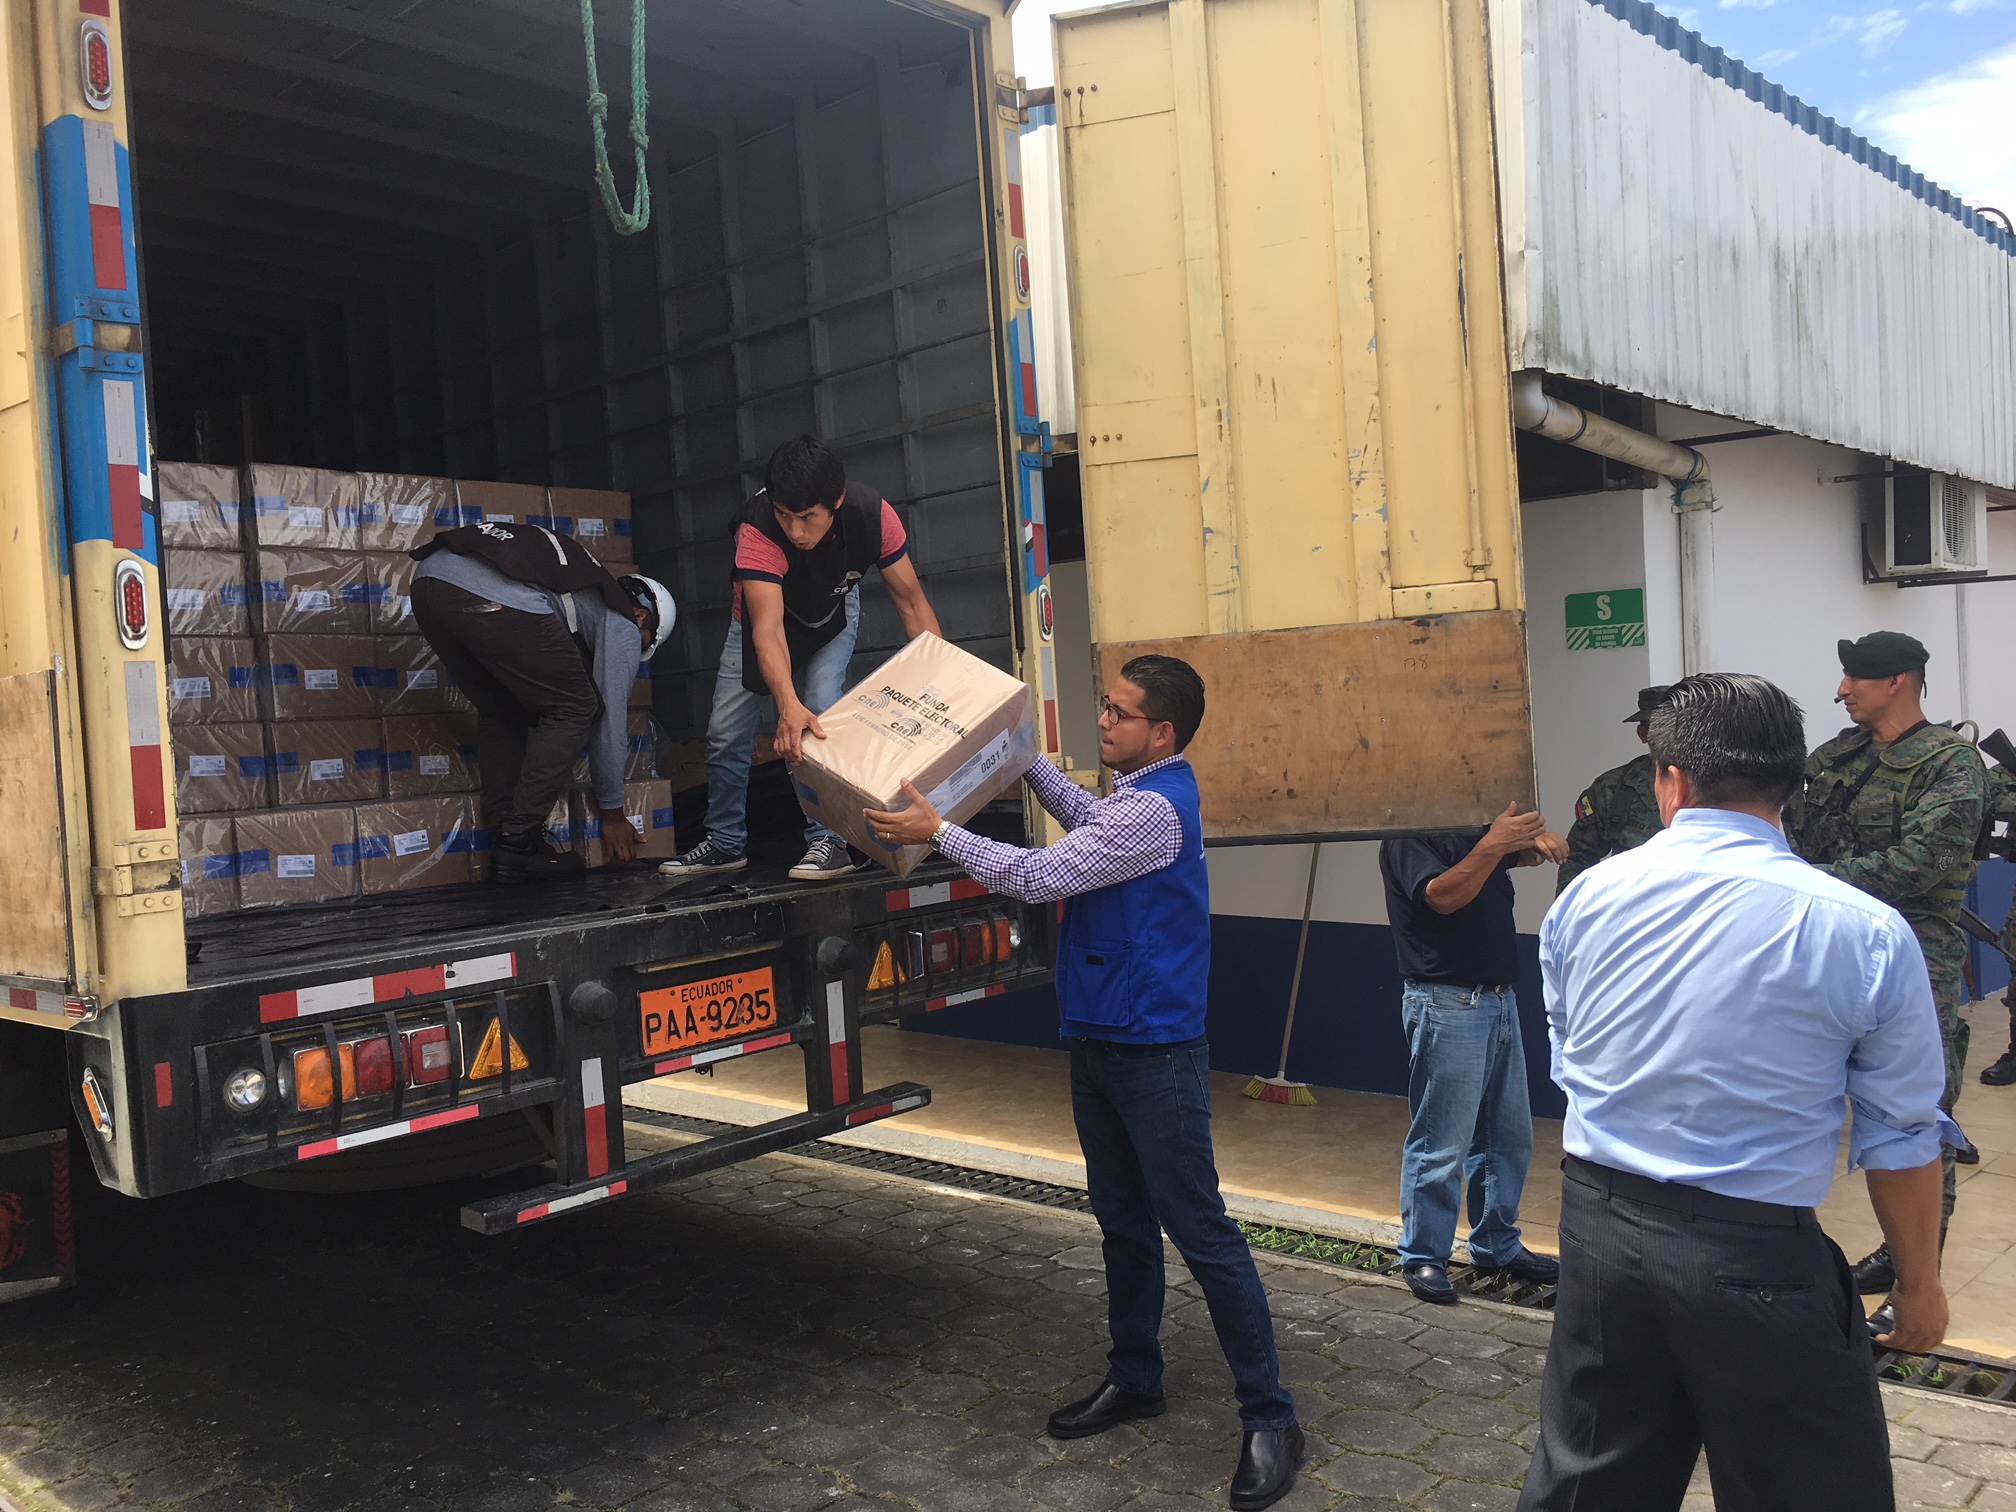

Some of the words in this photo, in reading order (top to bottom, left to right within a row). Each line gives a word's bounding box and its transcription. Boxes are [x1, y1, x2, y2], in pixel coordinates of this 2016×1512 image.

[1596, 594, 1612, 621] S
[880, 686, 920, 712] PAQUETE
[918, 707, 970, 740] ELECTORAL
[919, 693, 950, 714] FUNDA
[864, 719, 889, 737] FEBRERO
[980, 751, 1001, 773] 0031
[681, 979, 734, 1003] ECUADOR
[645, 988, 771, 1048] PAA-9235
